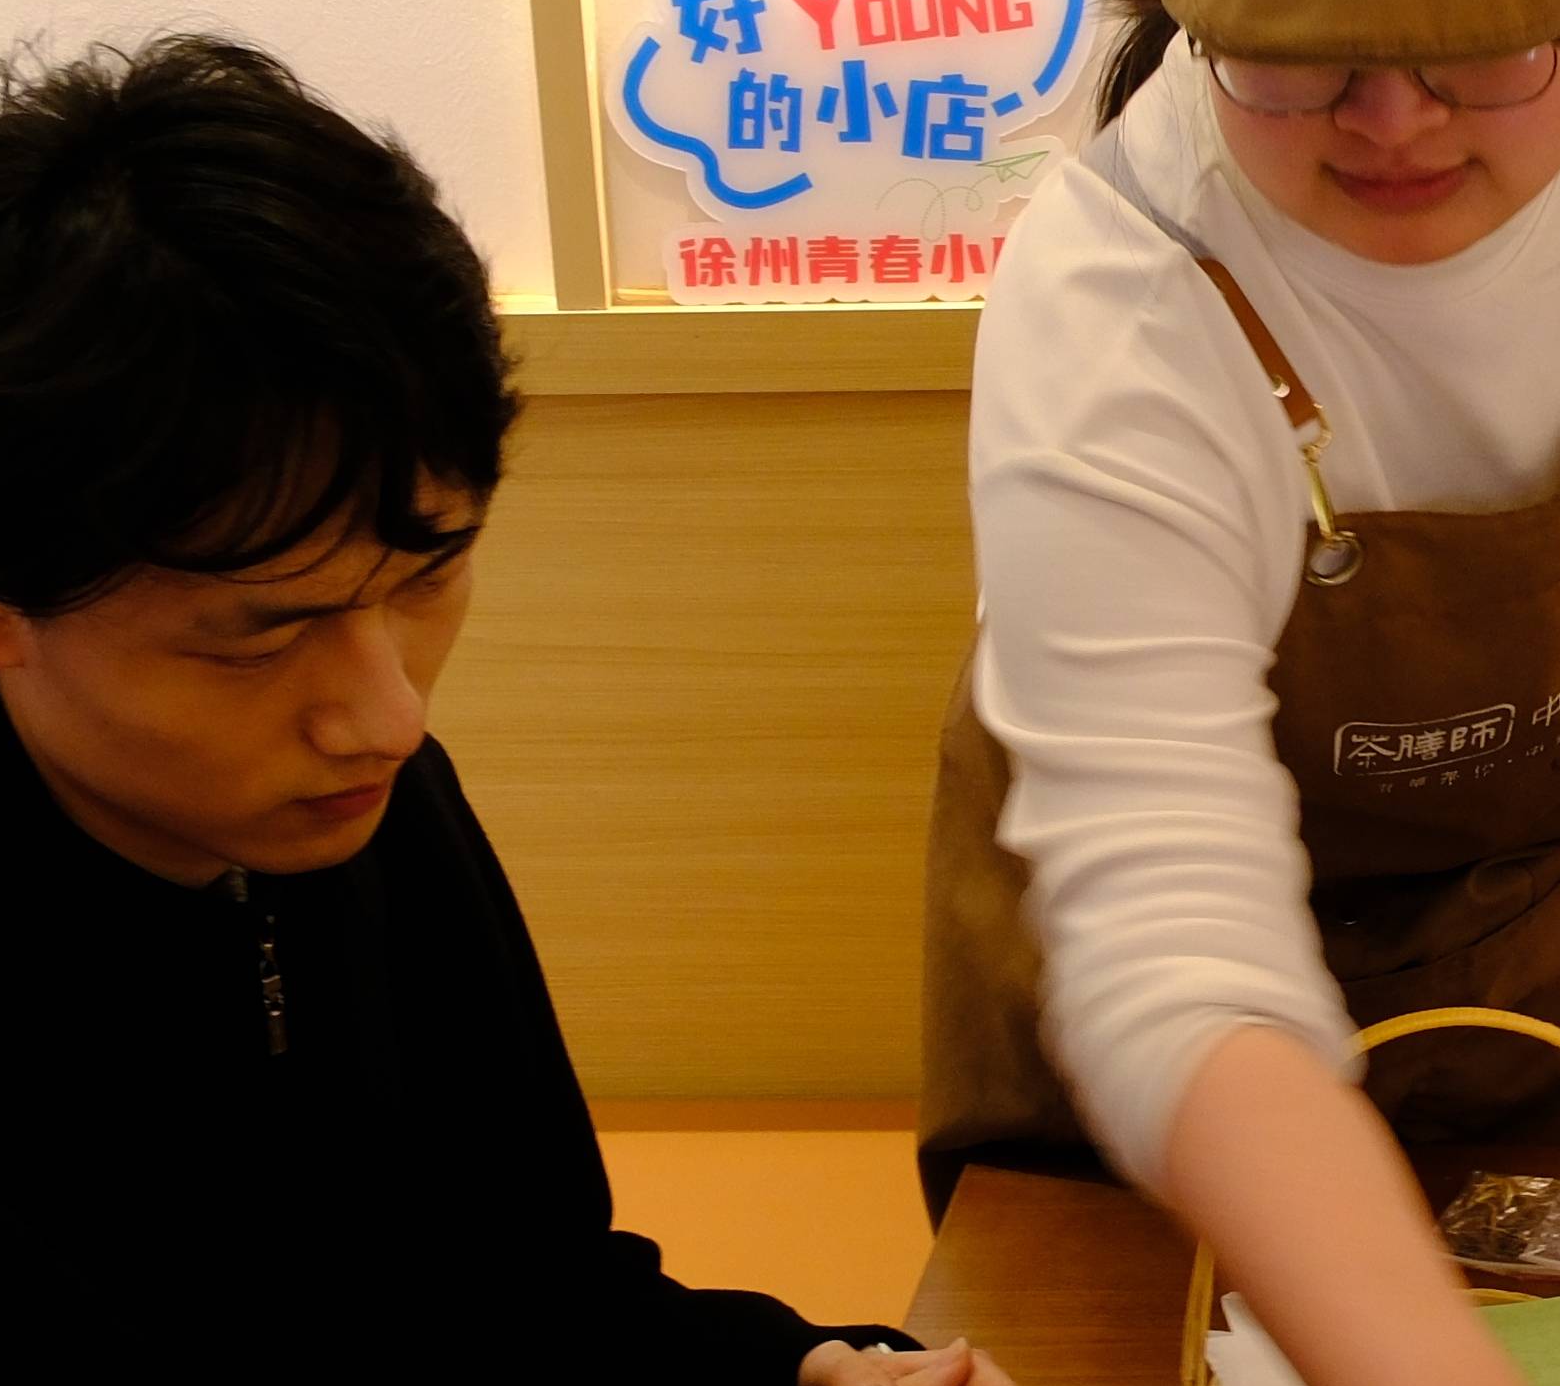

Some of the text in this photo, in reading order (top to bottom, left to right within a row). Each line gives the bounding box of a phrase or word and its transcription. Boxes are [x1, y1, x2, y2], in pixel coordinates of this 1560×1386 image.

[728, 59, 988, 162] 的小店
[679, 234, 1006, 288] 徐州青春小
[1346, 717, 1502, 771] 茶膳師
